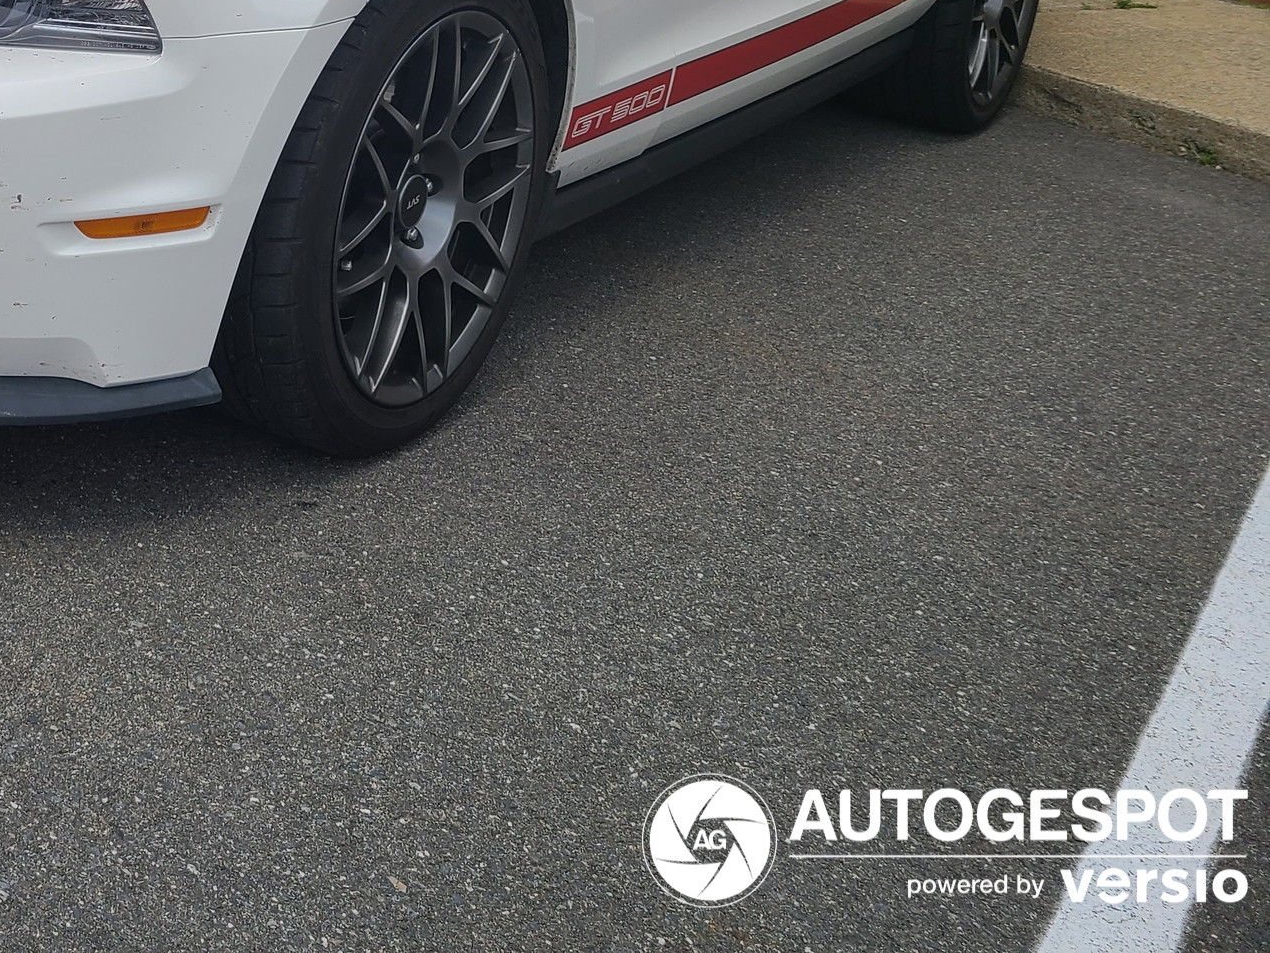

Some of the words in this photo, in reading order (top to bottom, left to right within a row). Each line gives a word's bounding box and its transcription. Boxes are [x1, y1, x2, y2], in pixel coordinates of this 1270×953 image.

[571, 105, 611, 139] GT
[610, 84, 666, 123] 500
[406, 194, 421, 210] SVT
